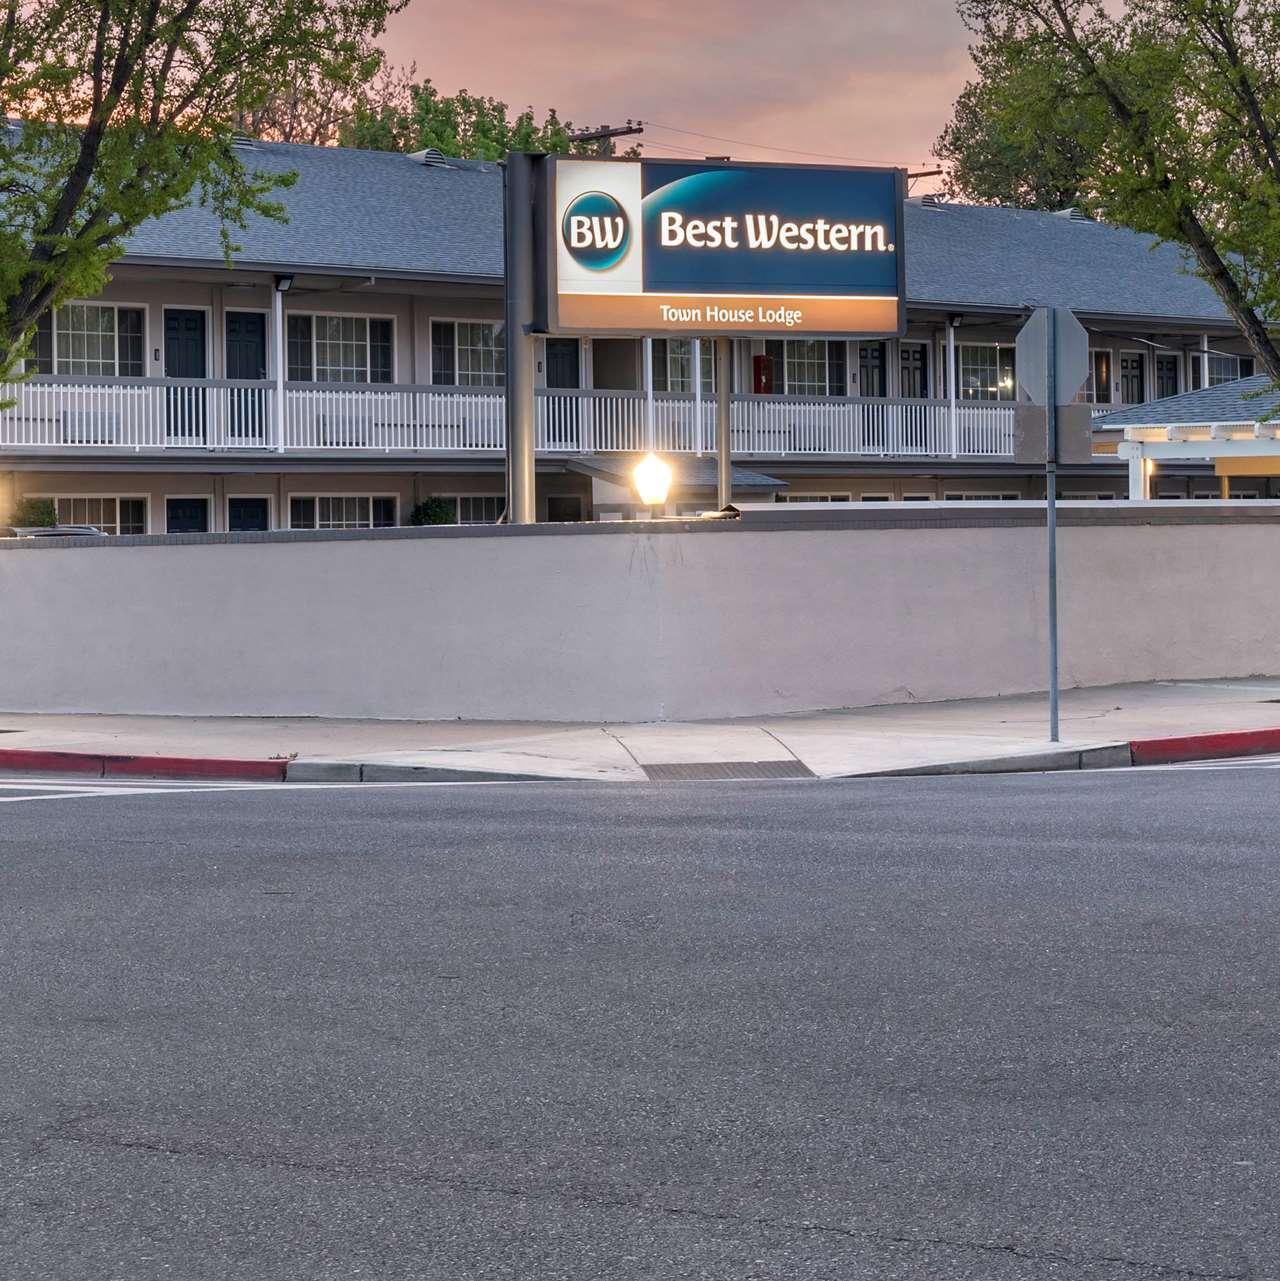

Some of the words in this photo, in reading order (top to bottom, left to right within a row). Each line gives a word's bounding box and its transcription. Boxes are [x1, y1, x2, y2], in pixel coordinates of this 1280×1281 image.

[570, 216, 624, 249] BW
[661, 212, 739, 249] Best
[660, 305, 701, 323] Town
[706, 306, 754, 323] House
[758, 307, 802, 326] Lodge
